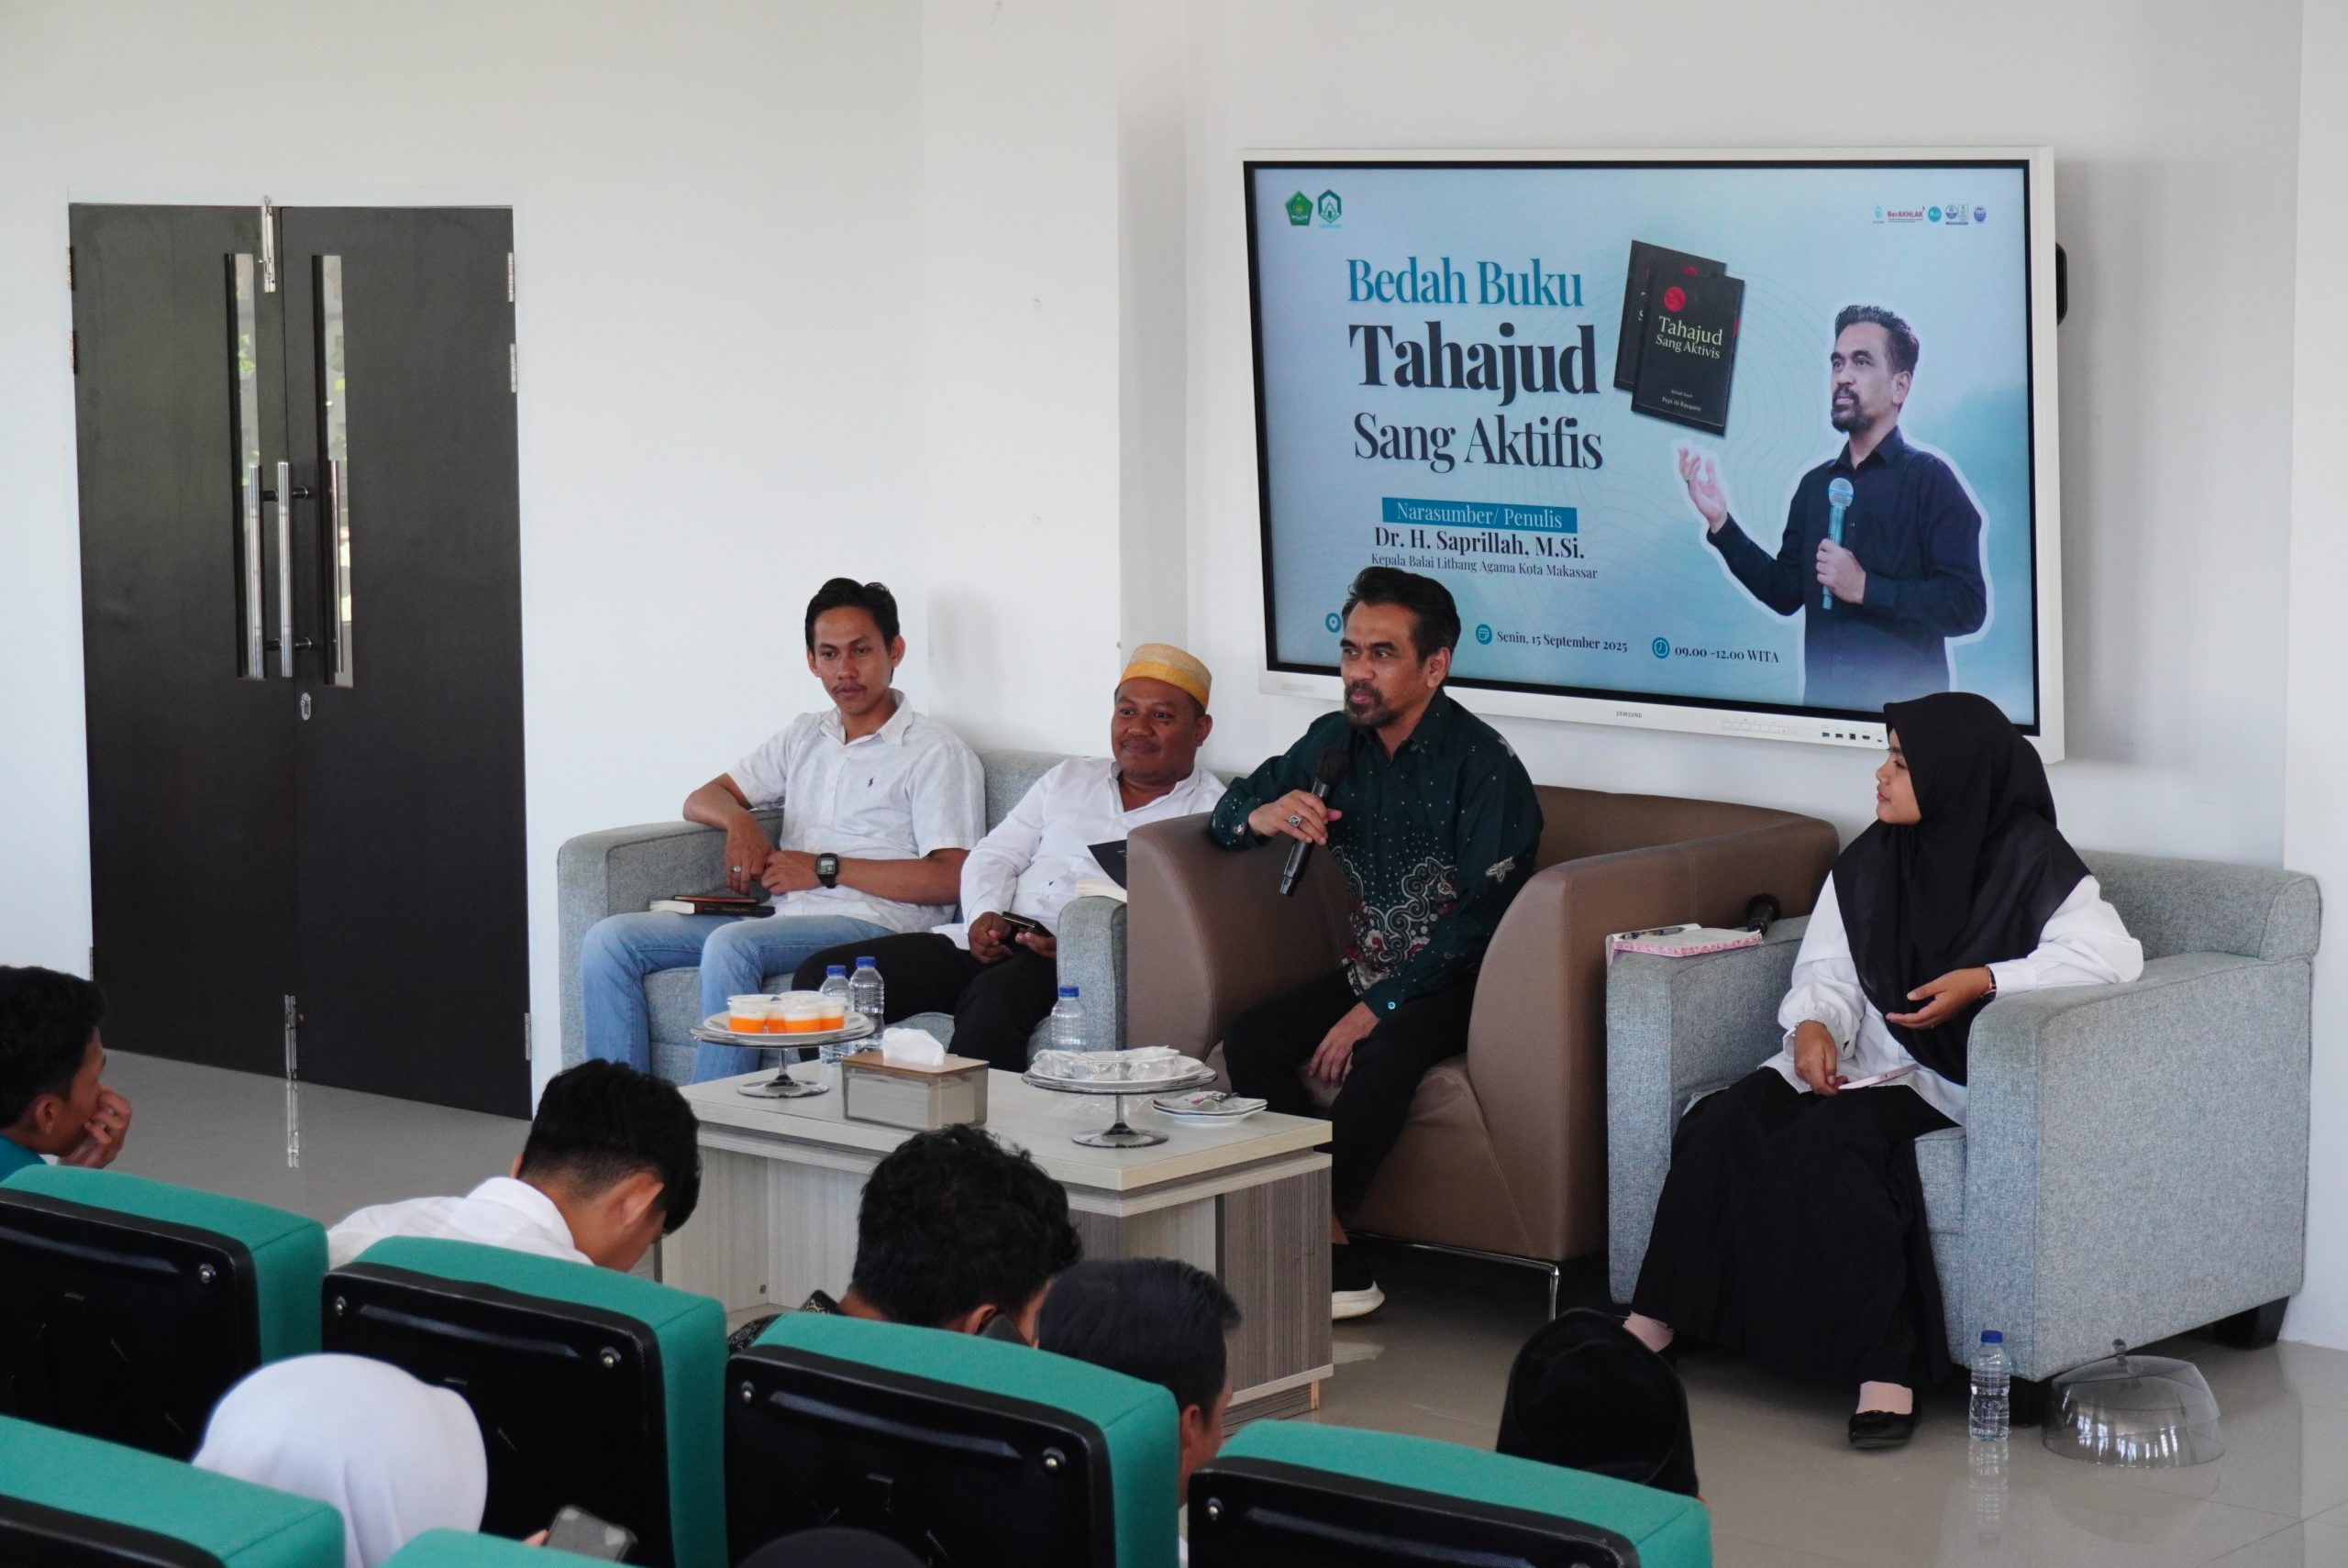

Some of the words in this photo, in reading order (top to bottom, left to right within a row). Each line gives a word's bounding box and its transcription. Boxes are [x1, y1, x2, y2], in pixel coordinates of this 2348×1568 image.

[1346, 257, 1468, 304] Bedah
[1477, 259, 1584, 306] Buku
[1658, 315, 1723, 346] Tahajud
[1656, 334, 1683, 353] Sang
[1683, 341, 1721, 359] Aktivis
[1349, 320, 1600, 406] Tahajud
[1355, 412, 1456, 473] Sang
[1464, 414, 1603, 469] Aktifis
[1396, 502, 1500, 527] Narasumber/
[1503, 508, 1563, 529] Penulis
[1375, 526, 1404, 548] Dr.
[1409, 529, 1432, 550] H.
[1435, 531, 1531, 558] Saprillah,
[1534, 536, 1585, 559] M.Si.
[1370, 553, 1407, 569] Kepala
[1409, 555, 1434, 568] Balai
[1436, 556, 1478, 573] Litbang
[1479, 558, 1516, 576] Agama
[1518, 561, 1544, 576] Kota
[1545, 564, 1598, 580] Makassar
[1497, 630, 1529, 646] Senin,
[1531, 635, 1542, 647] 15
[1543, 632, 1600, 652] September
[1602, 640, 1628, 654] 2025
[1675, 646, 1708, 659] 09.00
[1746, 649, 1779, 664] WITA
[1615, 711, 1643, 719] SAMSUNG
